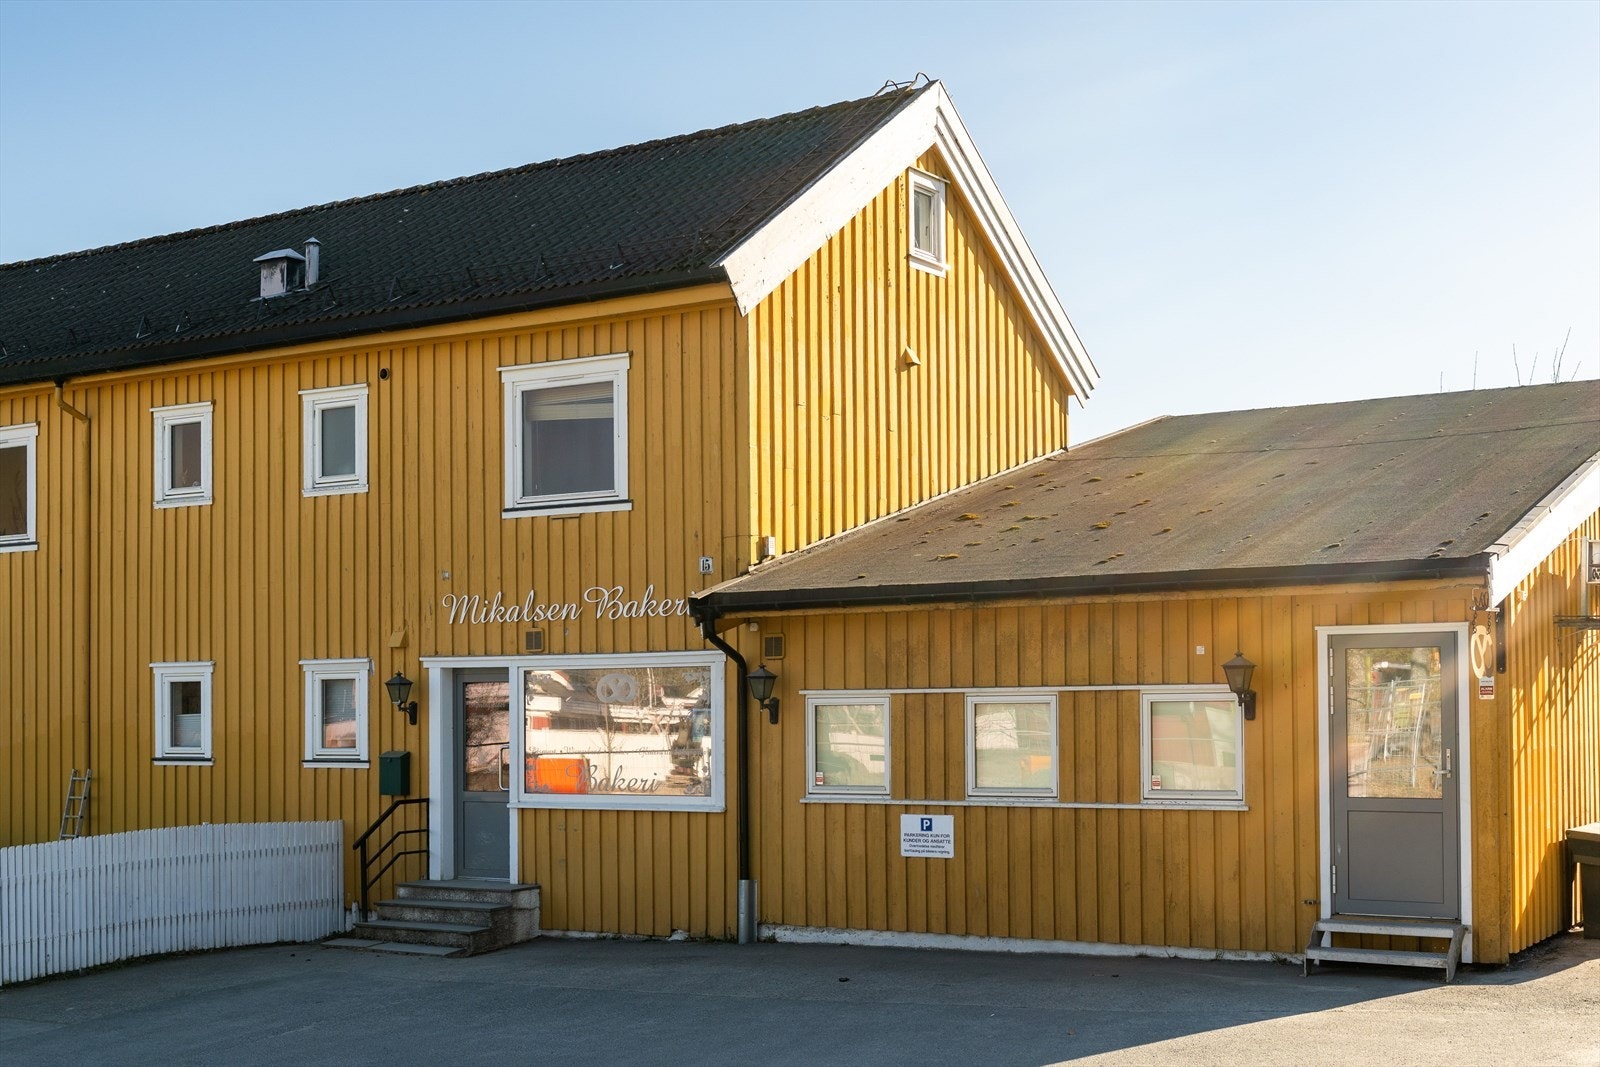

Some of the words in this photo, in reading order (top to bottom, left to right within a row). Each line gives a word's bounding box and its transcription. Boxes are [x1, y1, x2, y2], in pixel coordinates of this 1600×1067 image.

[702, 558, 711, 571] 15
[442, 589, 583, 625] Mikalsen
[565, 763, 662, 793] Bakeri
[923, 820, 930, 830] P
